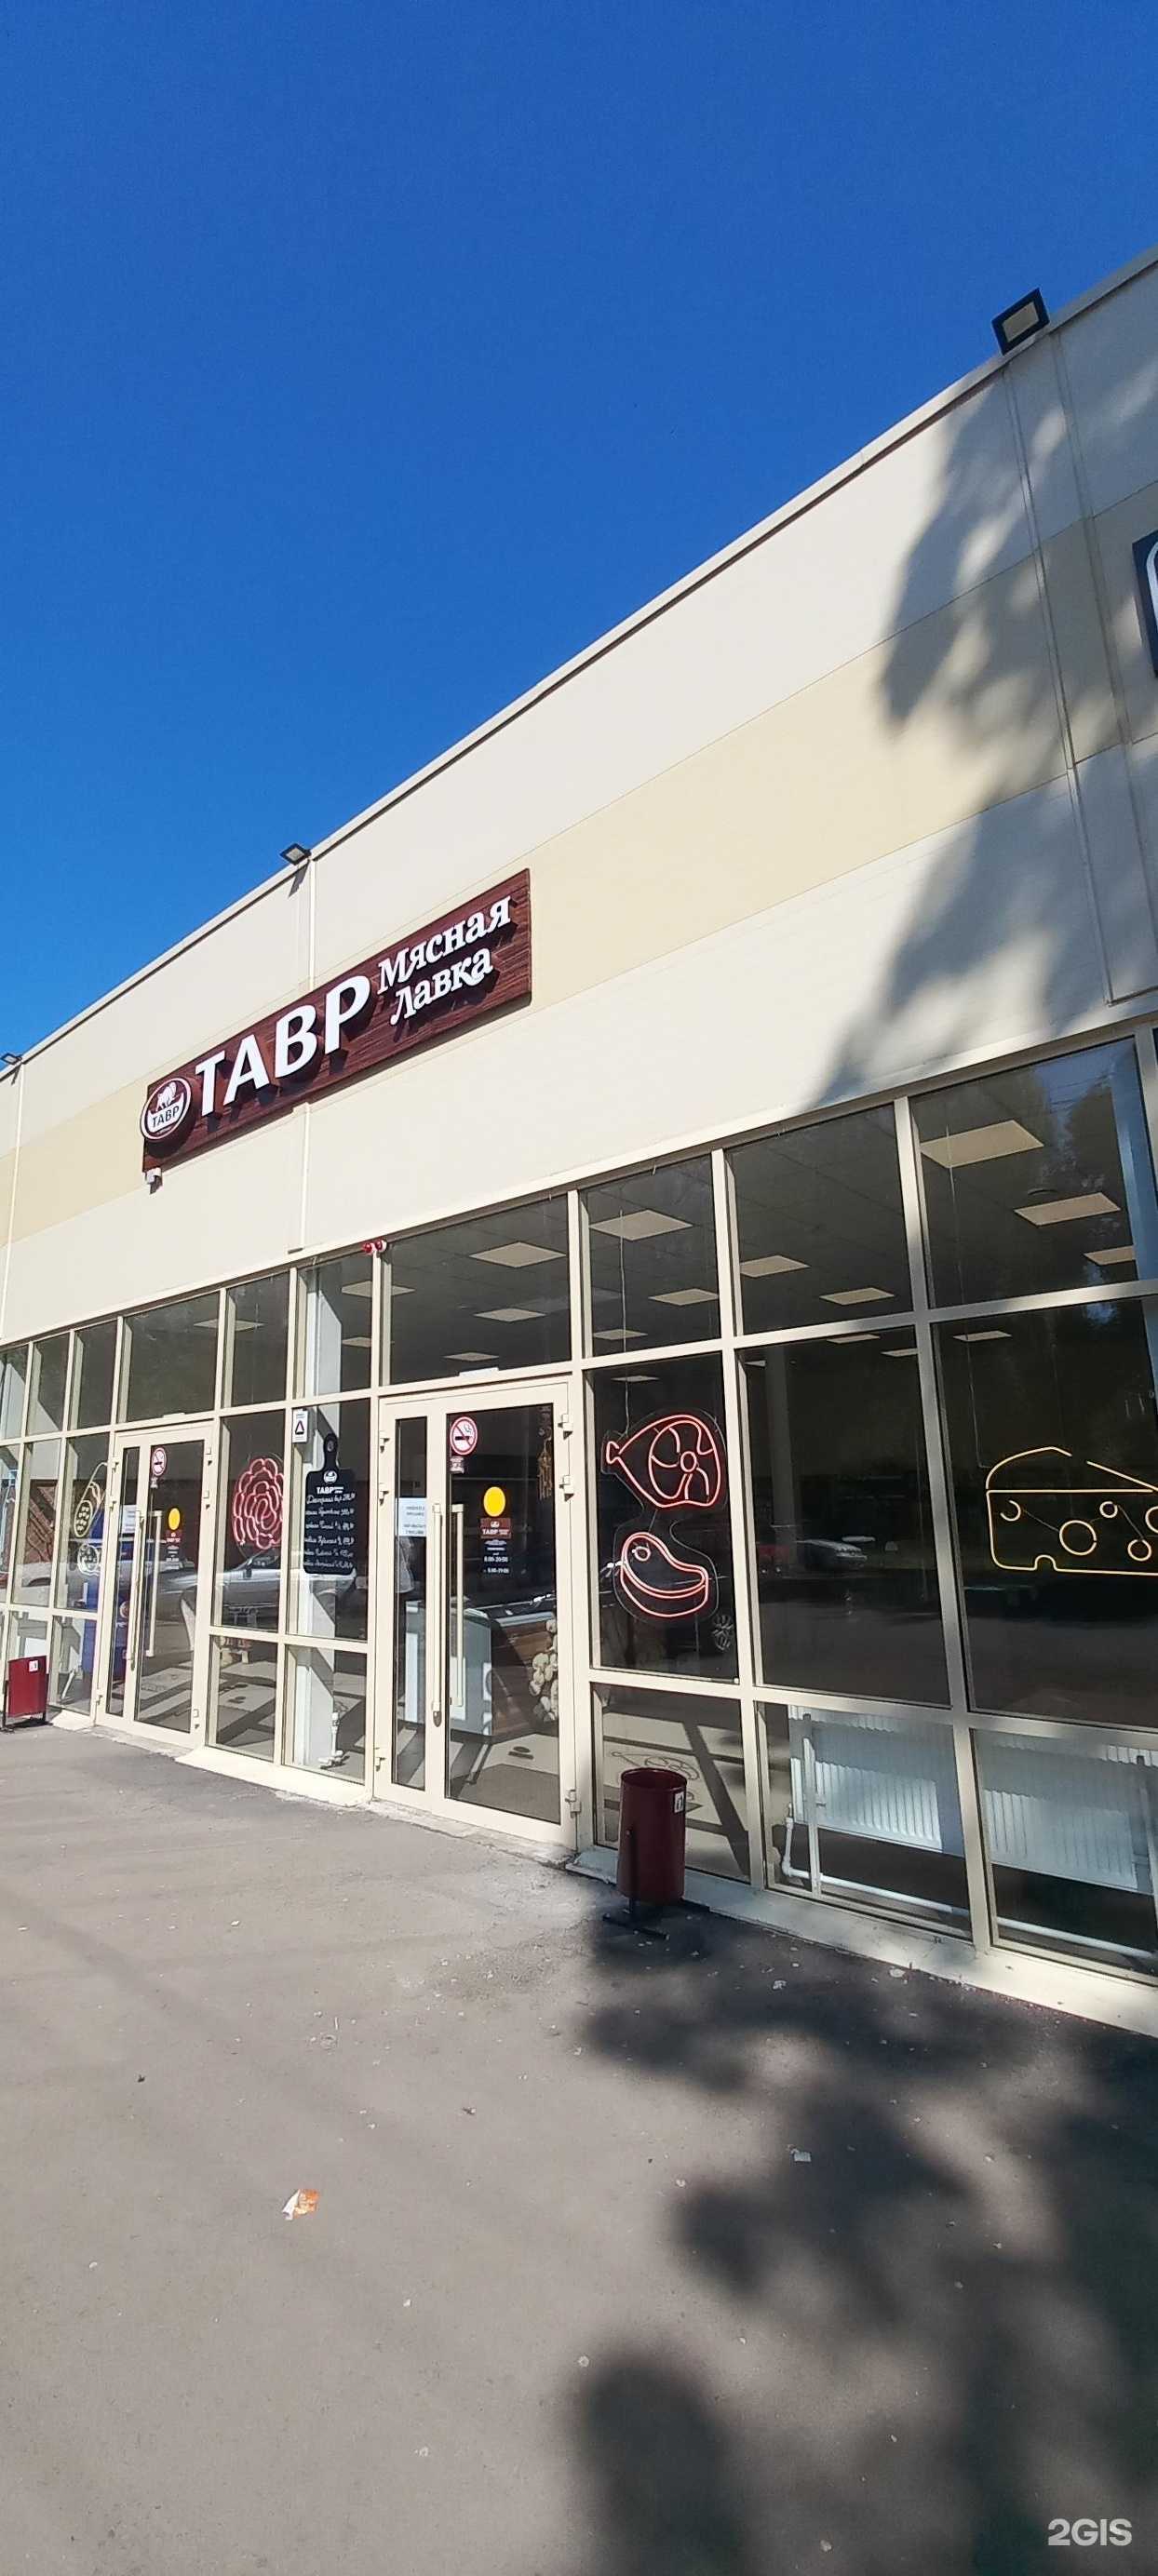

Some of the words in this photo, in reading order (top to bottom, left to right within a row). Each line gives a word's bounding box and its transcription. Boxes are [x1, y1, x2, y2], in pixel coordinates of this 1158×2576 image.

[376, 895, 511, 995] Мясная
[390, 947, 493, 1026] Лавка
[195, 975, 370, 1117] ТАВР
[153, 1105, 180, 1128] ТАВР
